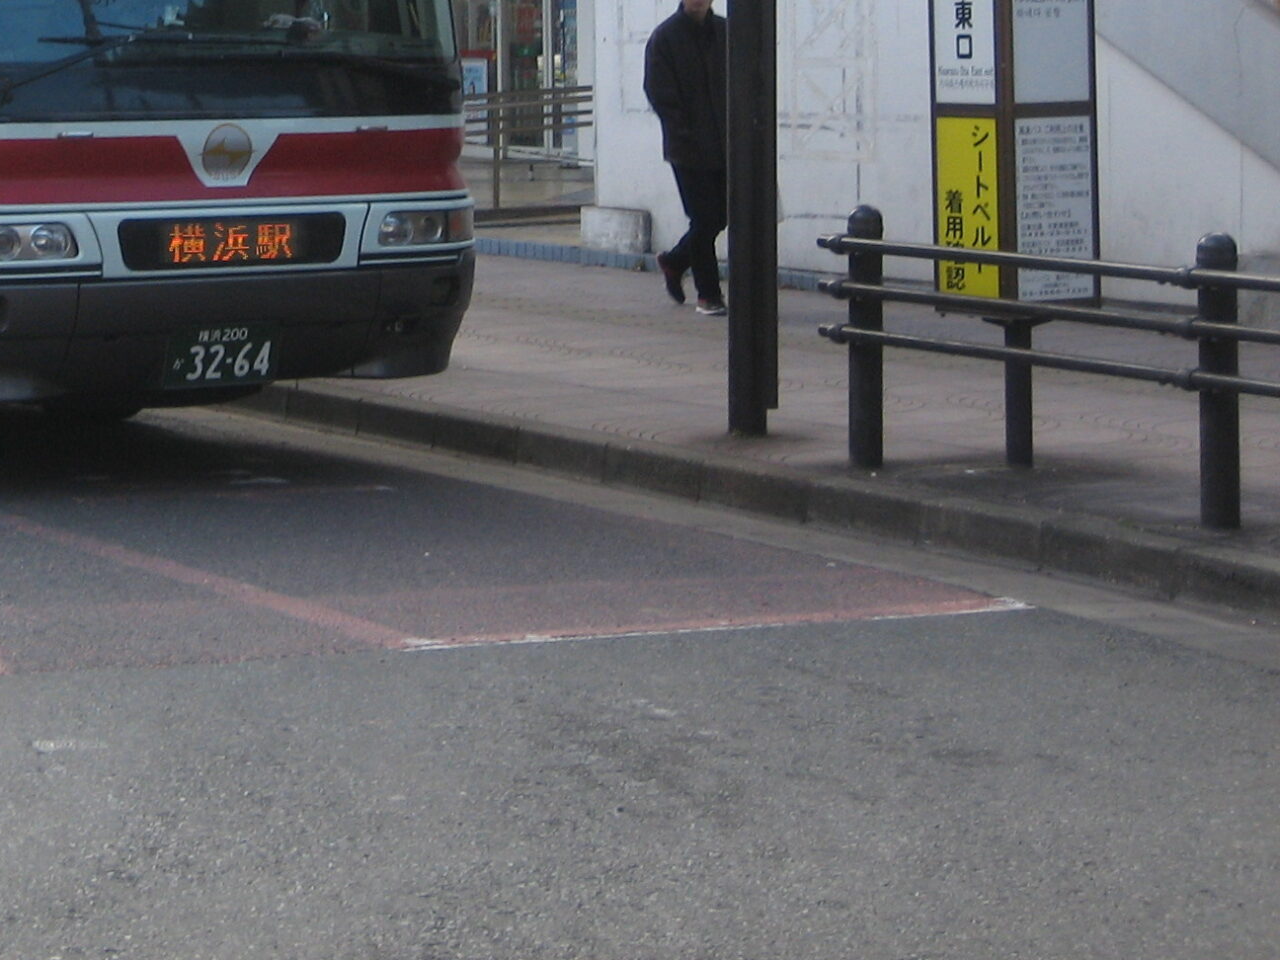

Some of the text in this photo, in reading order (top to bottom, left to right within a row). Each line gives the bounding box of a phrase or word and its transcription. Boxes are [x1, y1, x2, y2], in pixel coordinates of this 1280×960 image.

[168, 223, 294, 262] 横浜駅
[185, 340, 272, 380] 32-64
